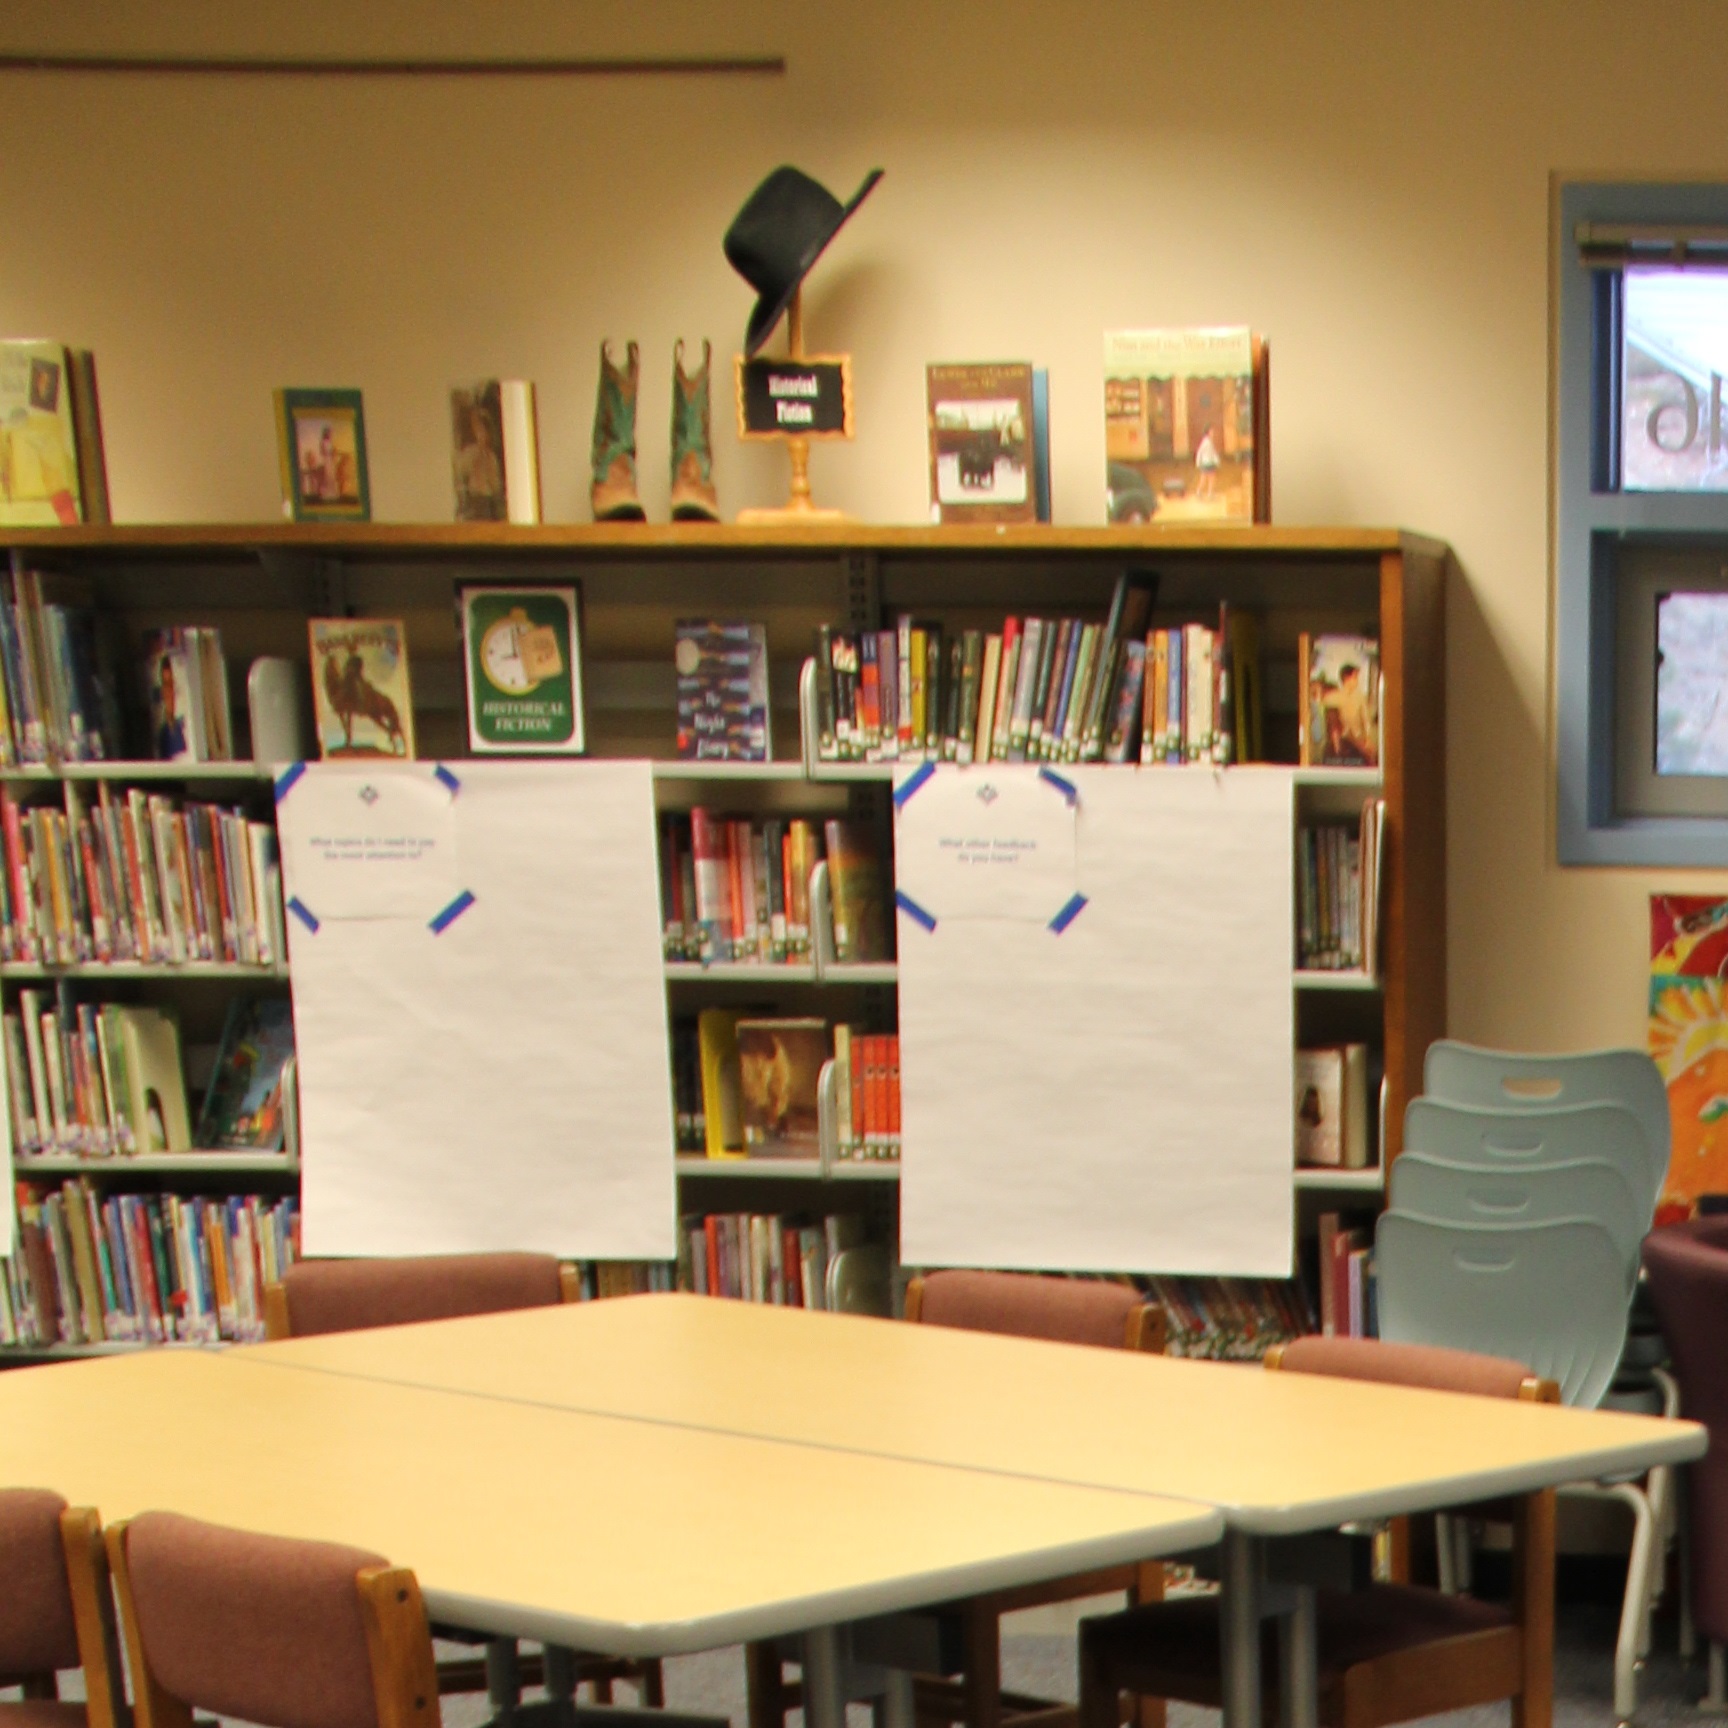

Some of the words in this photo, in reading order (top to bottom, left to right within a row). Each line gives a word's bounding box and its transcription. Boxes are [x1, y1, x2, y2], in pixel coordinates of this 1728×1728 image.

[767, 373, 818, 397] Historical
[776, 399, 813, 424] Fiction
[482, 702, 565, 716] HISTORICAL
[494, 717, 553, 732] FICTION
